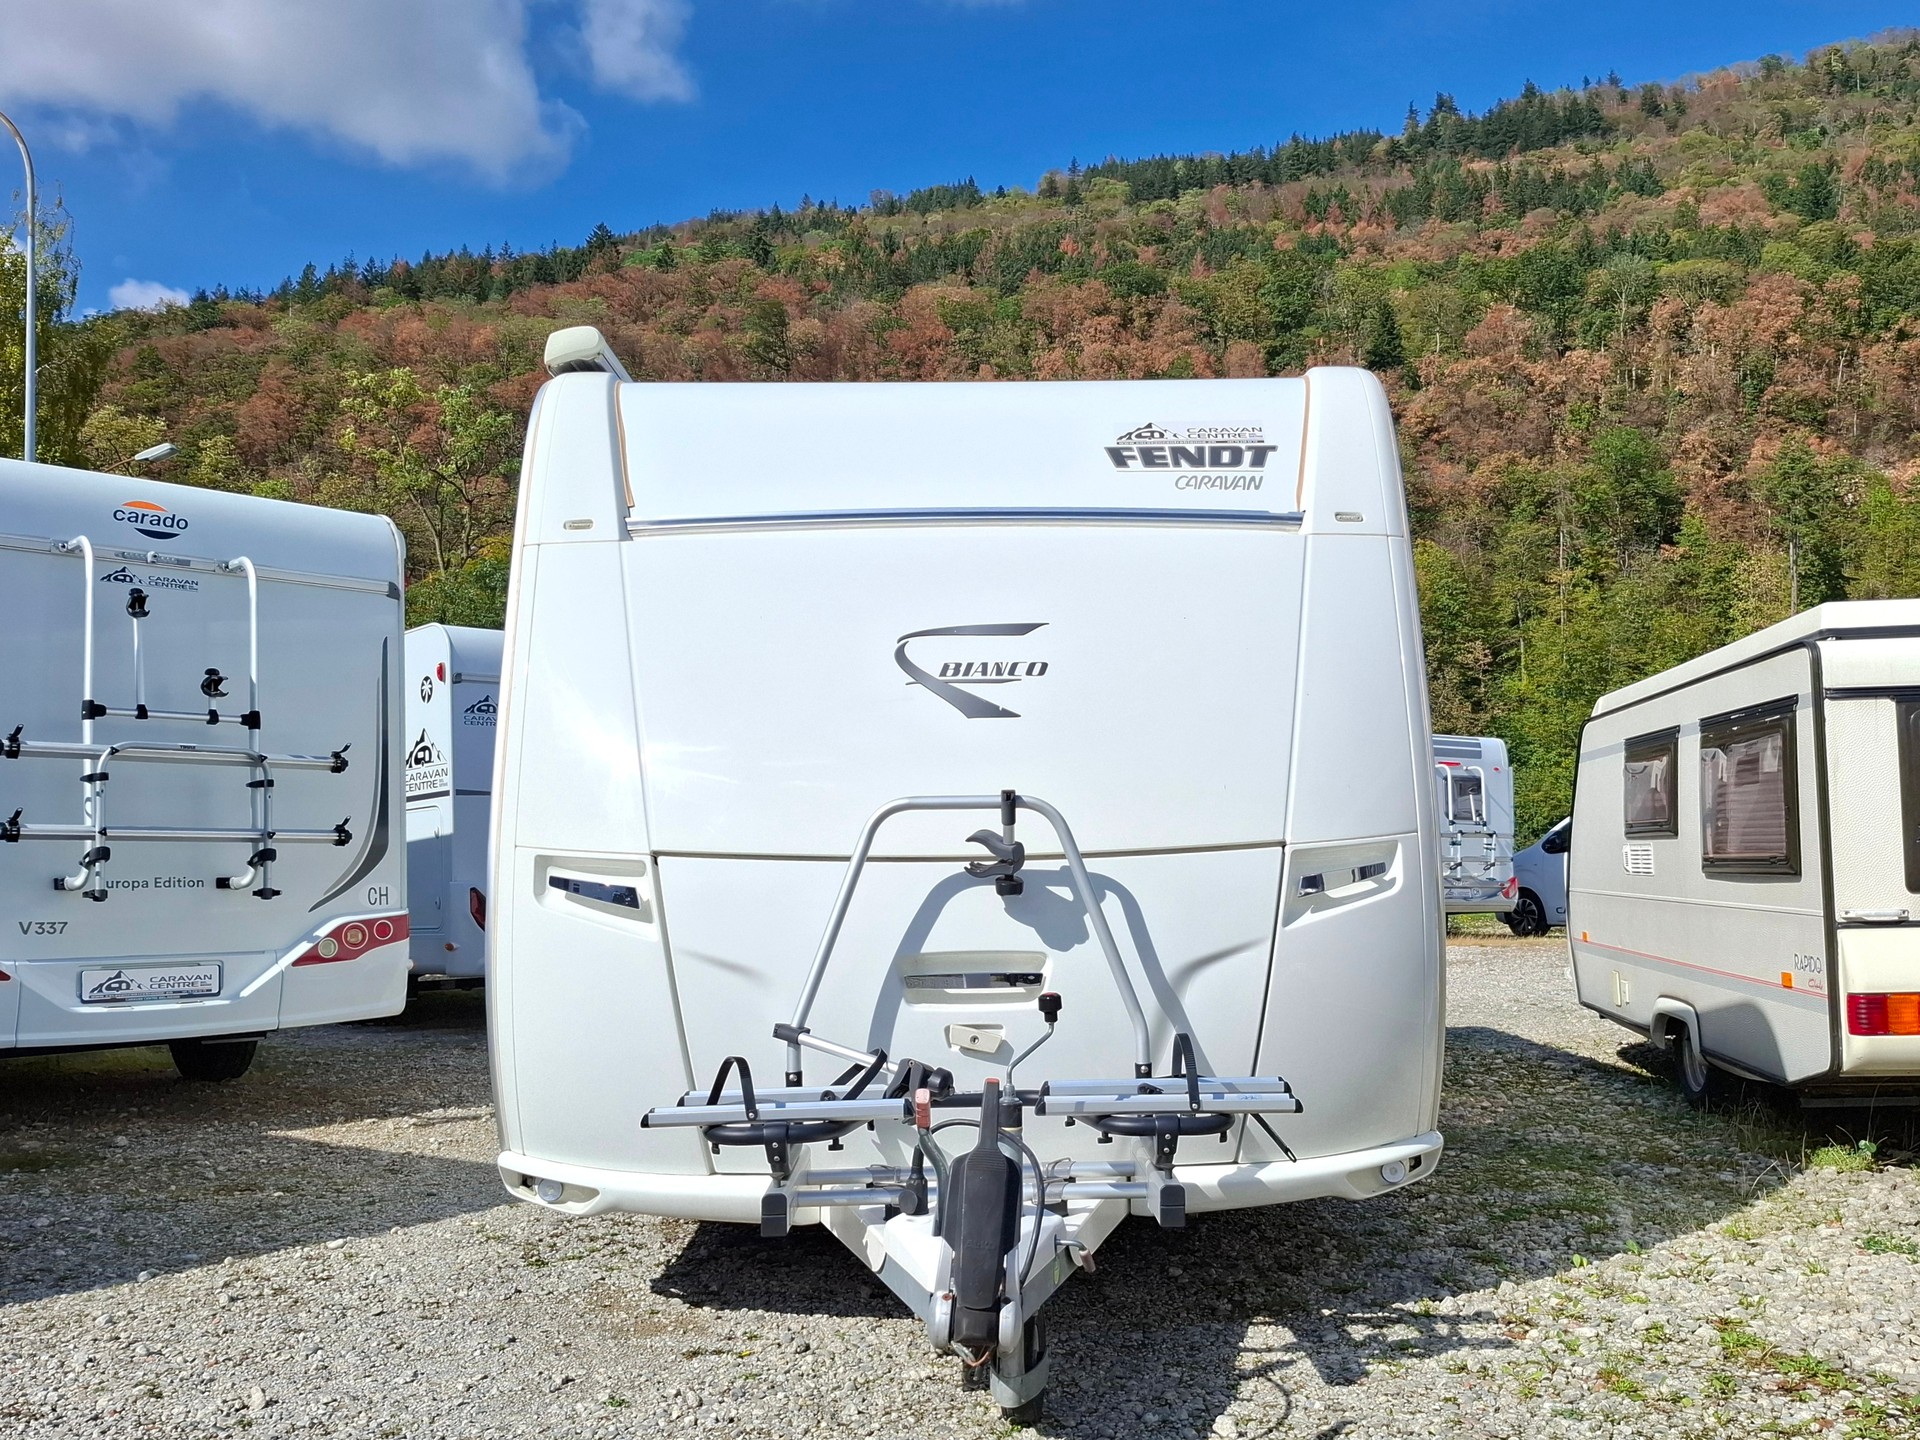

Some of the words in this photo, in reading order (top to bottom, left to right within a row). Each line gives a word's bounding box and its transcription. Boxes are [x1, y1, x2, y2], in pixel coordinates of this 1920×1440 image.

[1103, 445, 1278, 468] FENDT
[1175, 475, 1264, 491] CARAVAN
[113, 508, 189, 530] carado
[148, 575, 199, 586] CARAVAN
[148, 581, 187, 591] CENTRE
[938, 661, 1049, 678] BIANCO
[105, 880, 149, 891] uropa
[154, 877, 205, 888] Edition
[367, 886, 389, 906] CH
[150, 974, 212, 983] CARAVAN
